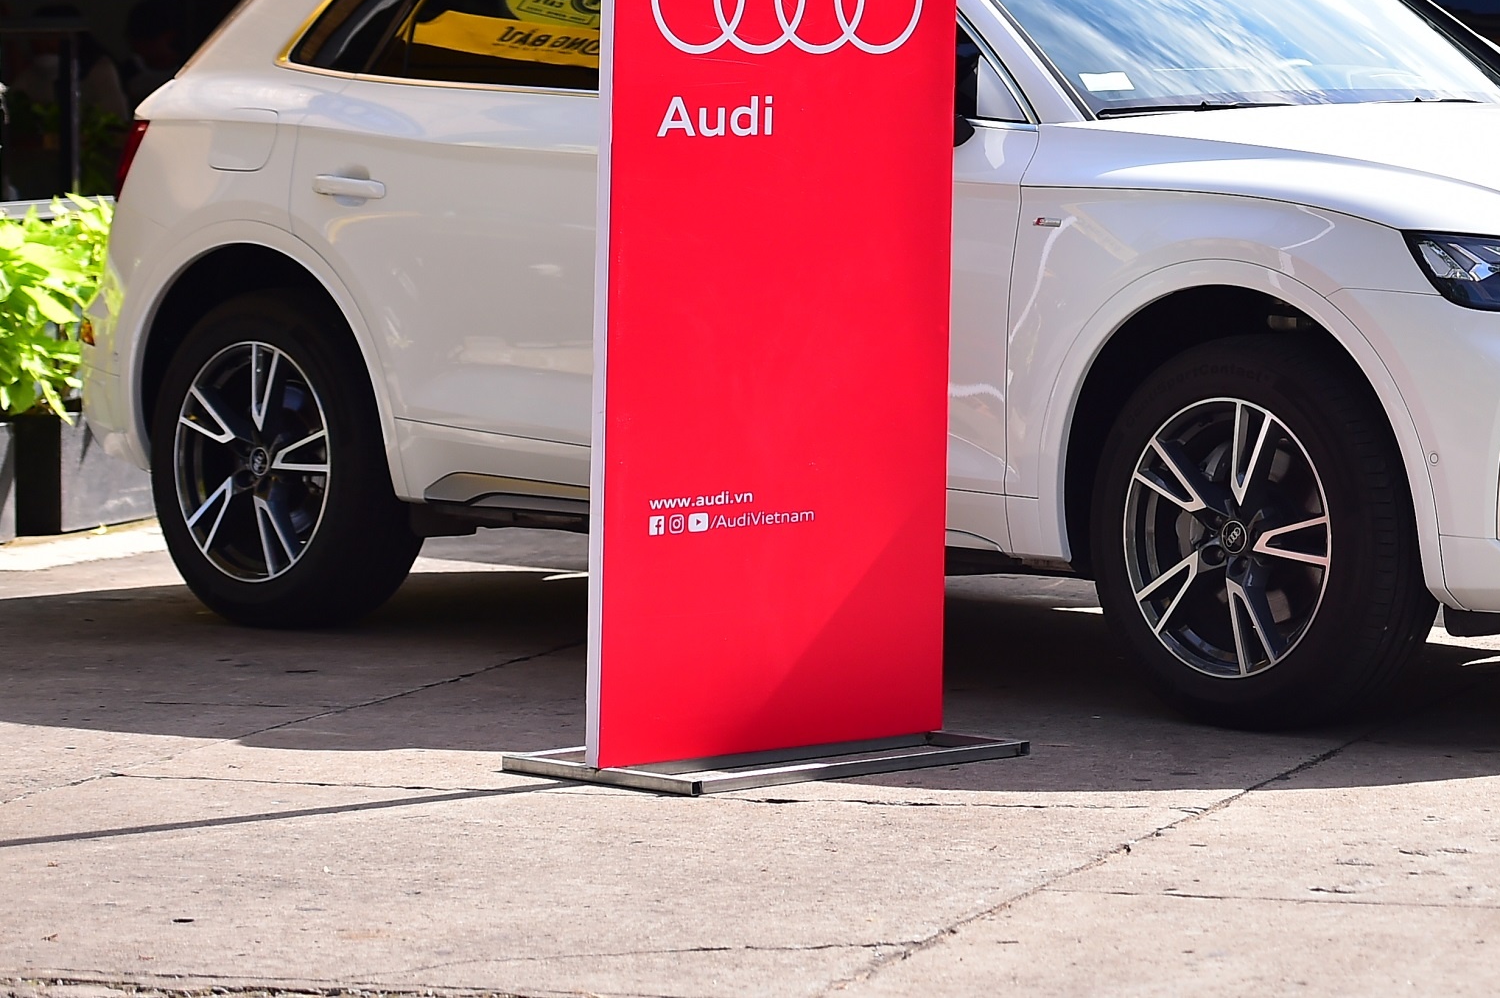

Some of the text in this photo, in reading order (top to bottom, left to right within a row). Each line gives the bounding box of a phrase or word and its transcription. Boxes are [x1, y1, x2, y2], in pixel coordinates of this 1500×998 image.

[657, 96, 774, 137] Audi
[649, 491, 753, 510] www.audi.vn
[710, 510, 815, 529] /AudiVietnam
